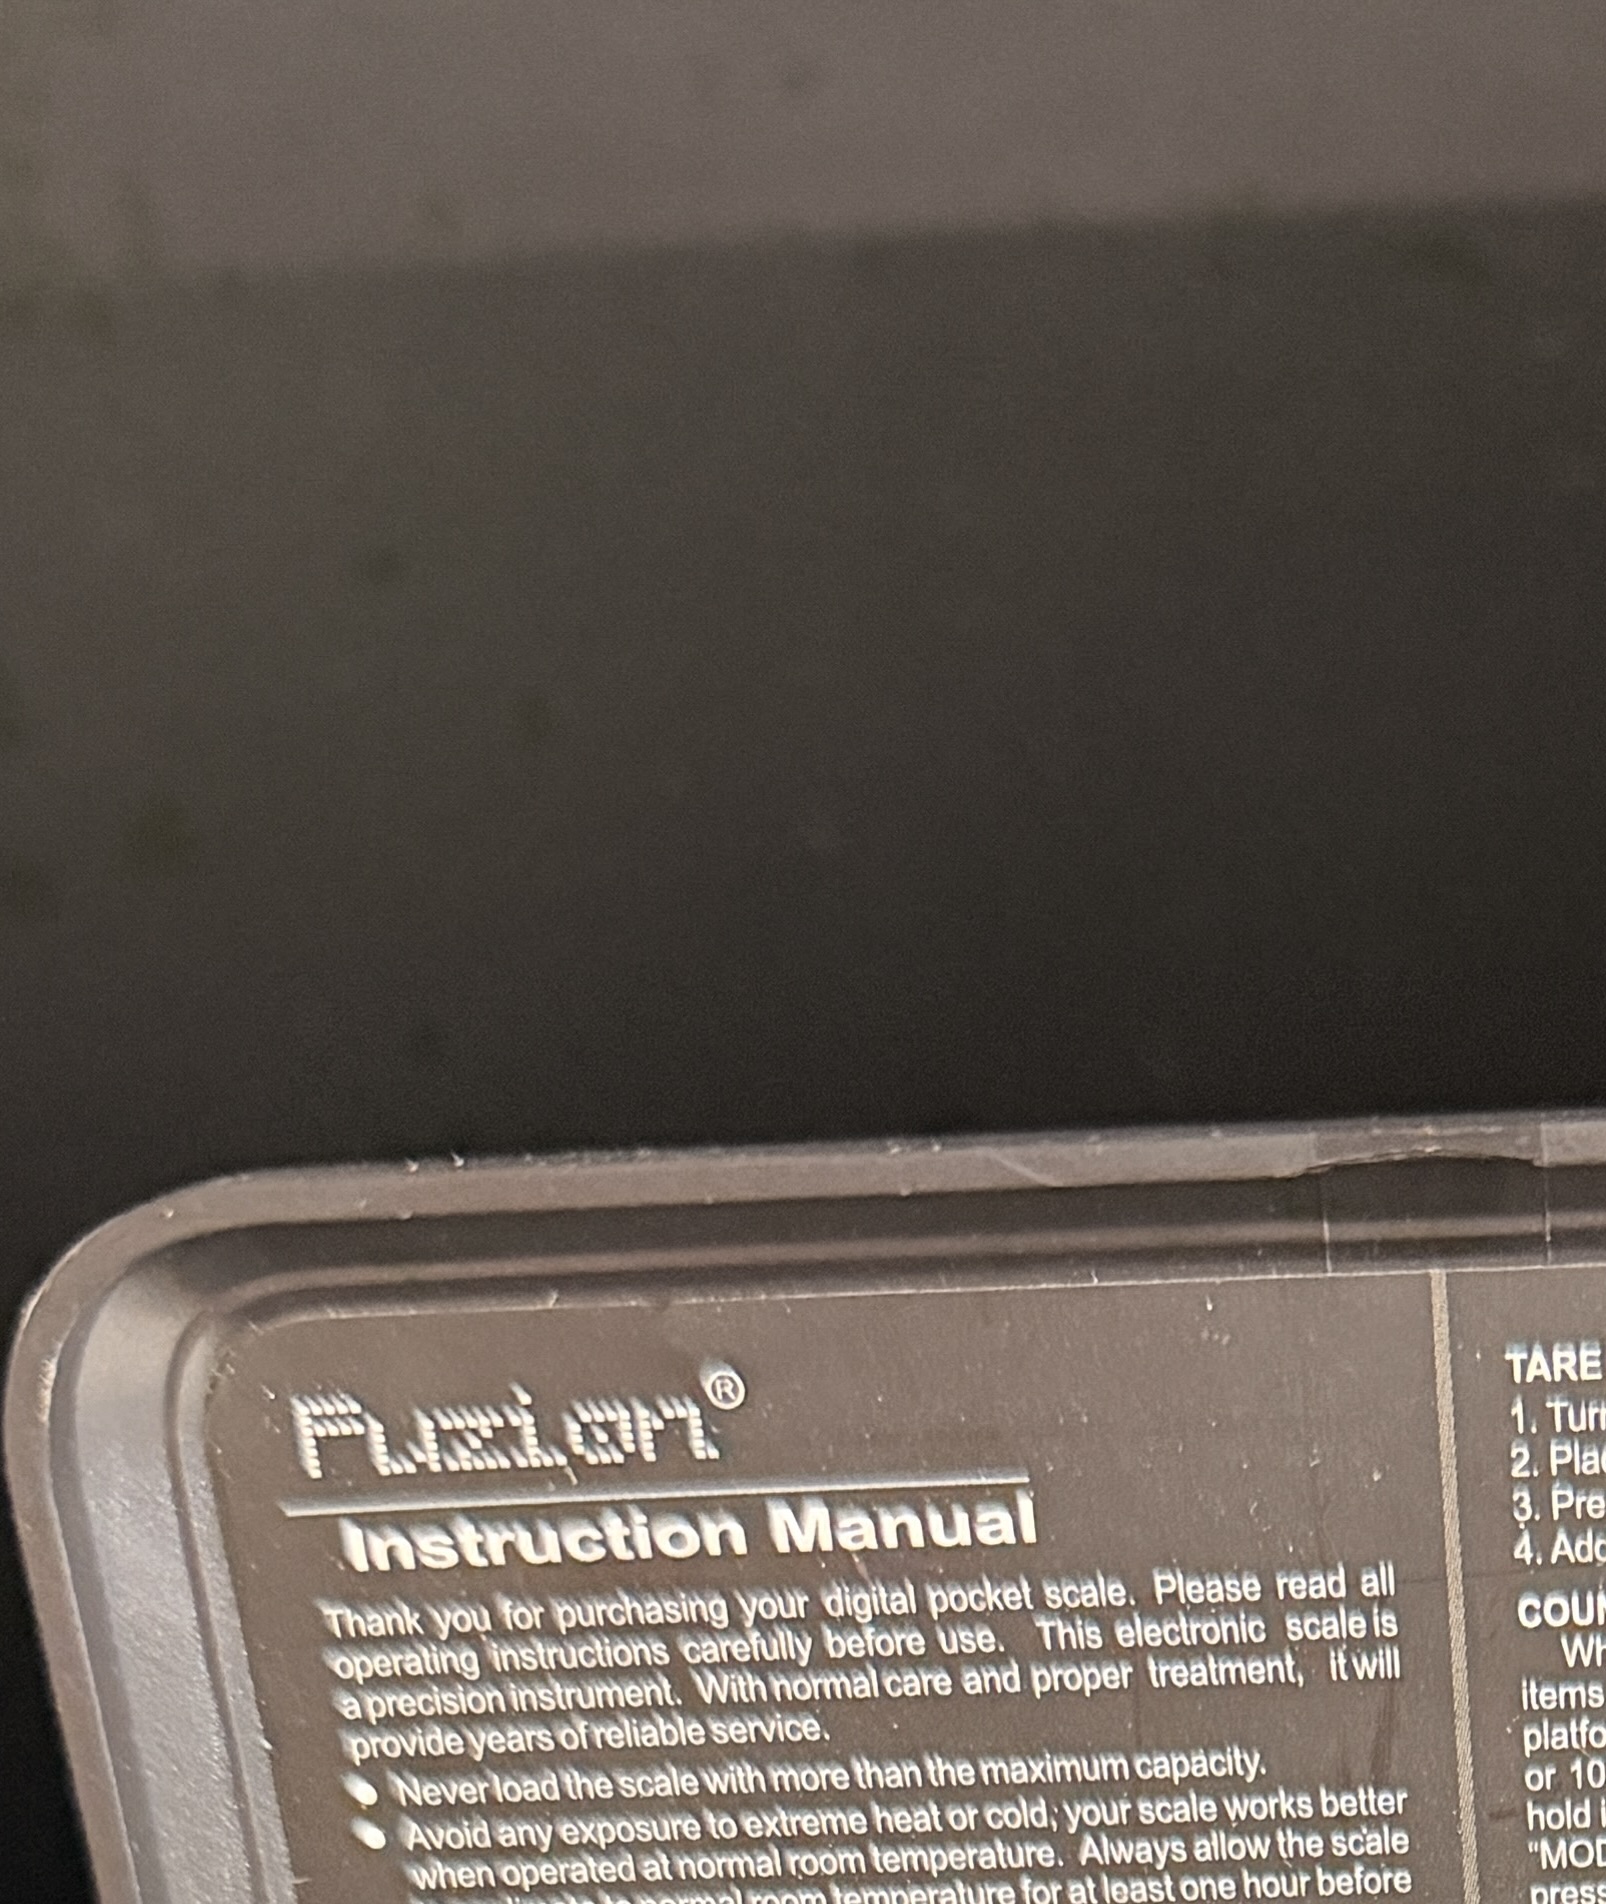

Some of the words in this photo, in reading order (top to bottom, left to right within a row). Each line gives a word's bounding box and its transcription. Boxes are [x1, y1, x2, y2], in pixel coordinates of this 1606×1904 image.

[1507, 1349, 1602, 1384] TARE
[1512, 1405, 1536, 1435] 1.
[340, 1509, 748, 1573] Instruction
[769, 1497, 1037, 1554] Manual
[1514, 1535, 1542, 1565] 4.
[326, 1607, 424, 1639] Thank
[431, 1611, 492, 1640] you
[499, 1602, 547, 1632] for
[553, 1595, 728, 1636] purchasing
[740, 1598, 810, 1628] your
[822, 1588, 917, 1625] digital
[928, 1583, 1033, 1621] pocket
[1044, 1579, 1135, 1611] scale.
[1155, 1574, 1262, 1606] Please
[1276, 1571, 1347, 1602] read
[1361, 1569, 1395, 1598] all
[350, 1724, 465, 1762] provide
[464, 1727, 555, 1758] years
[555, 1720, 588, 1749] of
[591, 1715, 706, 1747] reliable
[708, 1711, 829, 1743] service.
[391, 1774, 492, 1806] Never
[491, 1772, 561, 1802] load
[562, 1770, 614, 1800] the
[616, 1767, 699, 1798] scale
[701, 1765, 766, 1795] with
[769, 1769, 850, 1793] more
[854, 1760, 922, 1790] than
[927, 1758, 976, 1788] the
[980, 1753, 1129, 1786] maximum
[1133, 1748, 1266, 1786] capacity.
[1525, 1769, 1556, 1792] or
